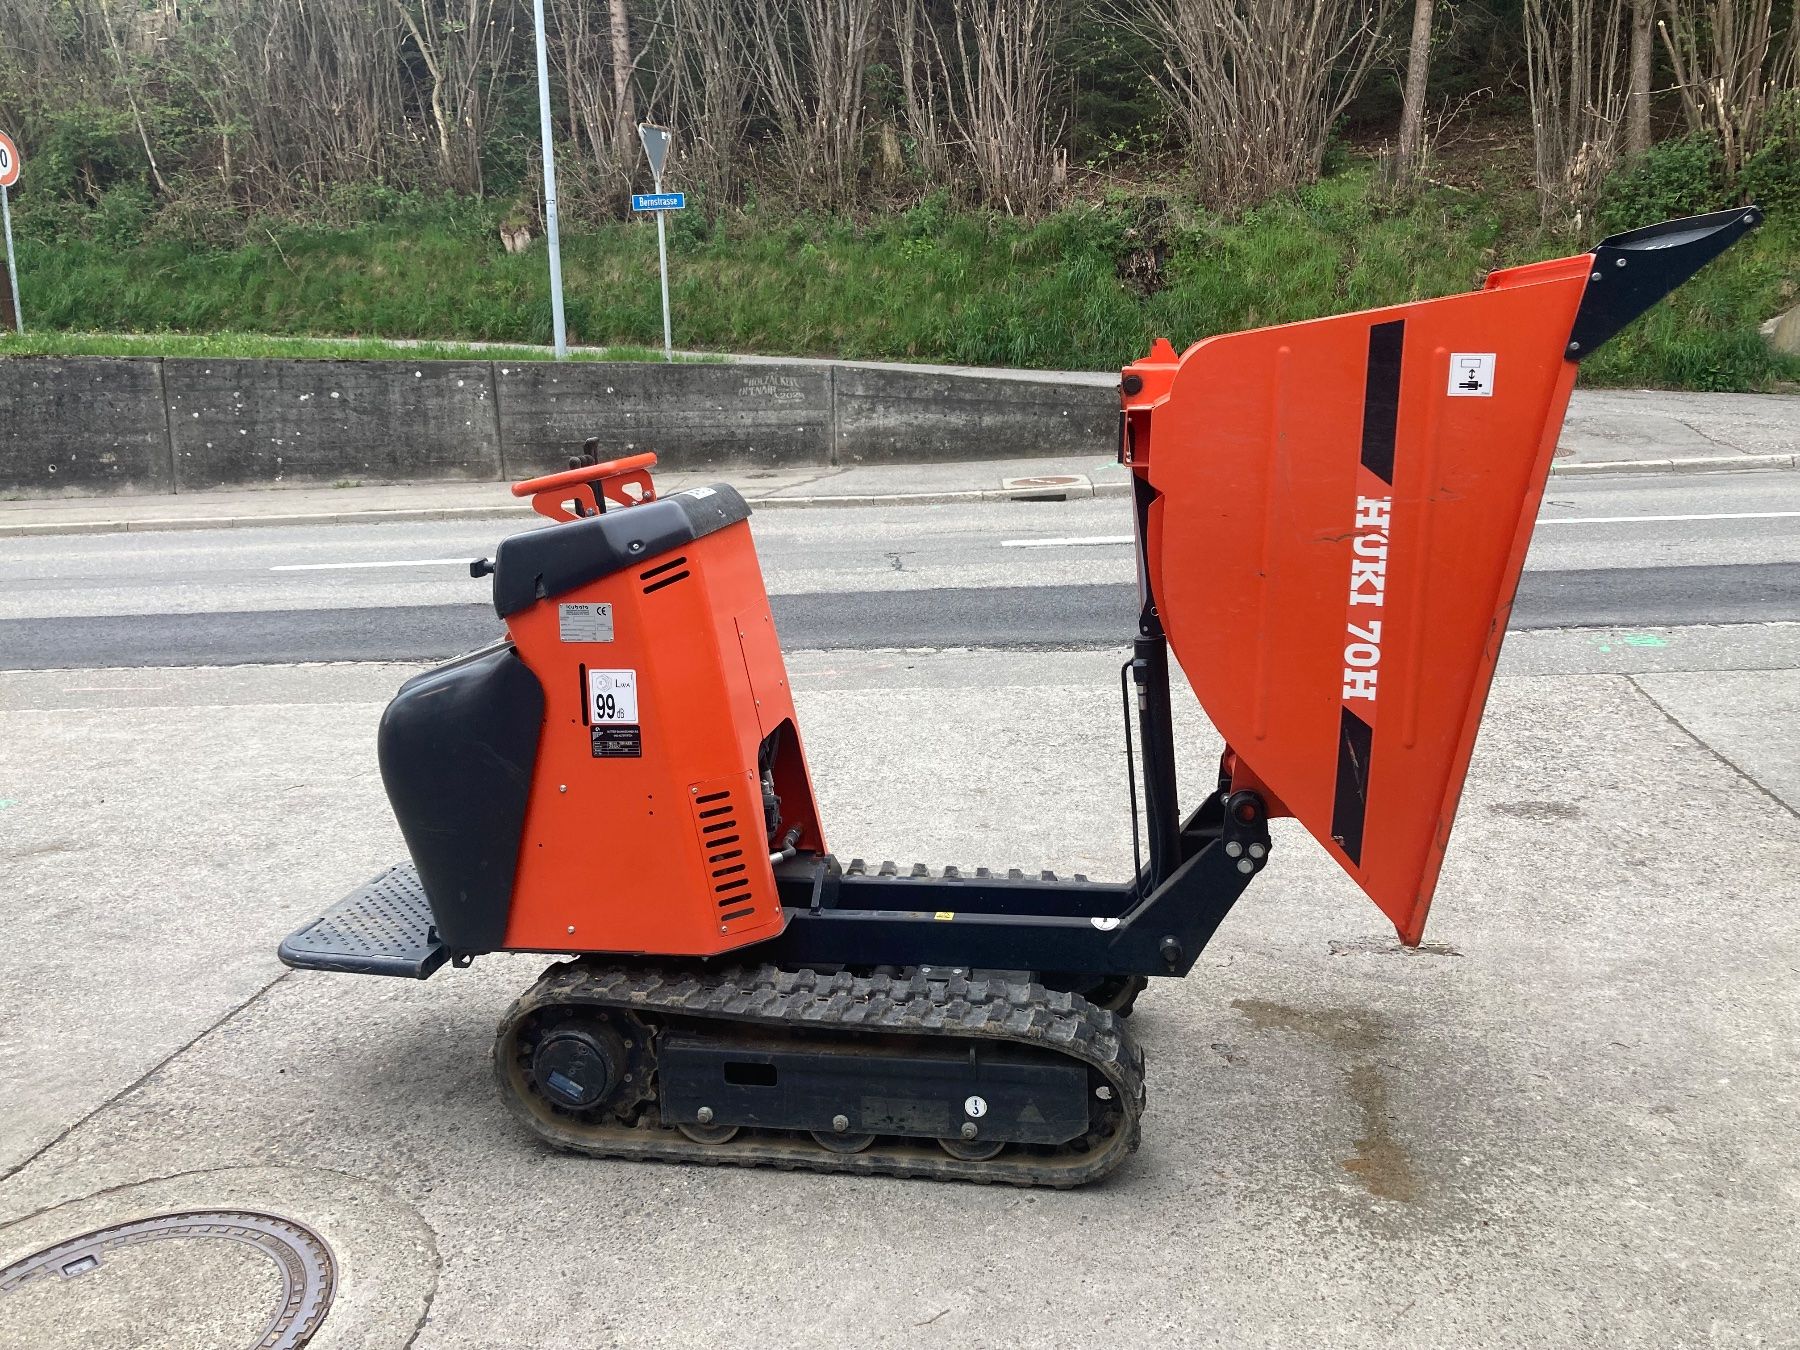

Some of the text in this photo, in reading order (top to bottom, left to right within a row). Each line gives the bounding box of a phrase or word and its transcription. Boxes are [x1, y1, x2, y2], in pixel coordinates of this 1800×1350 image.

[639, 197, 678, 207] Bernstrasse
[1342, 495, 1392, 701] HUKI 70H
[596, 693, 616, 719] 99
